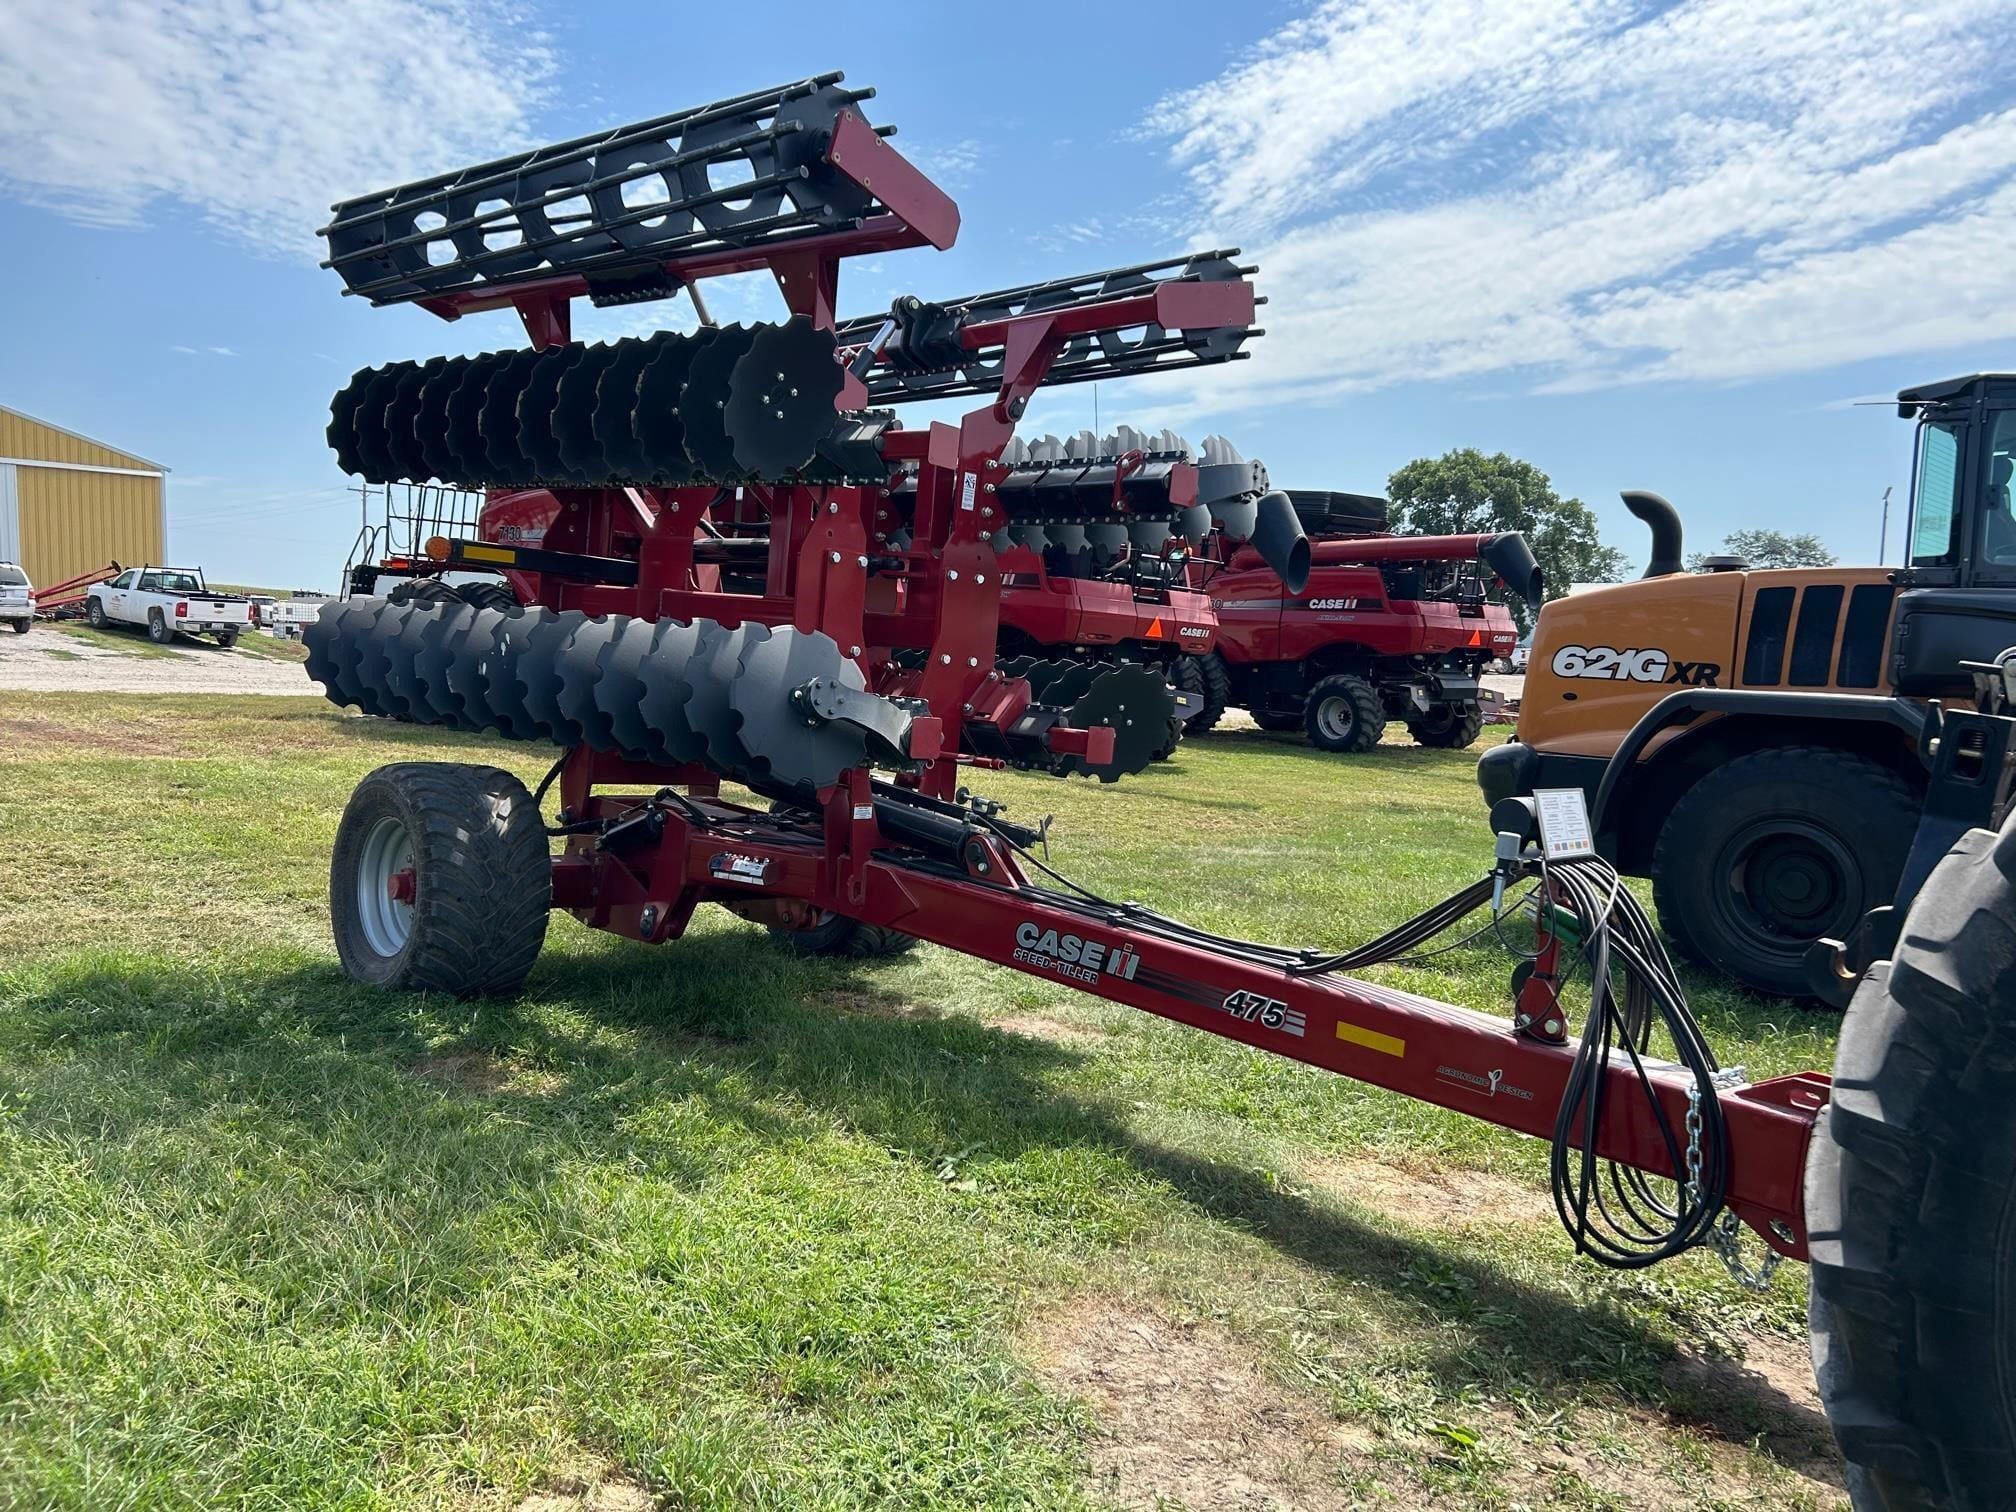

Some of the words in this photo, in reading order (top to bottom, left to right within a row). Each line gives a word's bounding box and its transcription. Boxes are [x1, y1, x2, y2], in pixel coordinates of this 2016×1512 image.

[499, 526, 521, 541] 7130
[1309, 598, 1345, 609] CASE
[1180, 627, 1203, 637] CASE
[1552, 645, 1669, 683] 621G
[1665, 662, 1721, 686] XR
[1016, 922, 1106, 970] CASE
[1013, 947, 1099, 985] SPEED-TILLER
[1222, 989, 1288, 1030] 475
[1436, 1065, 1491, 1087] AGRONOMIC
[1496, 1083, 1534, 1101] DESIGN
